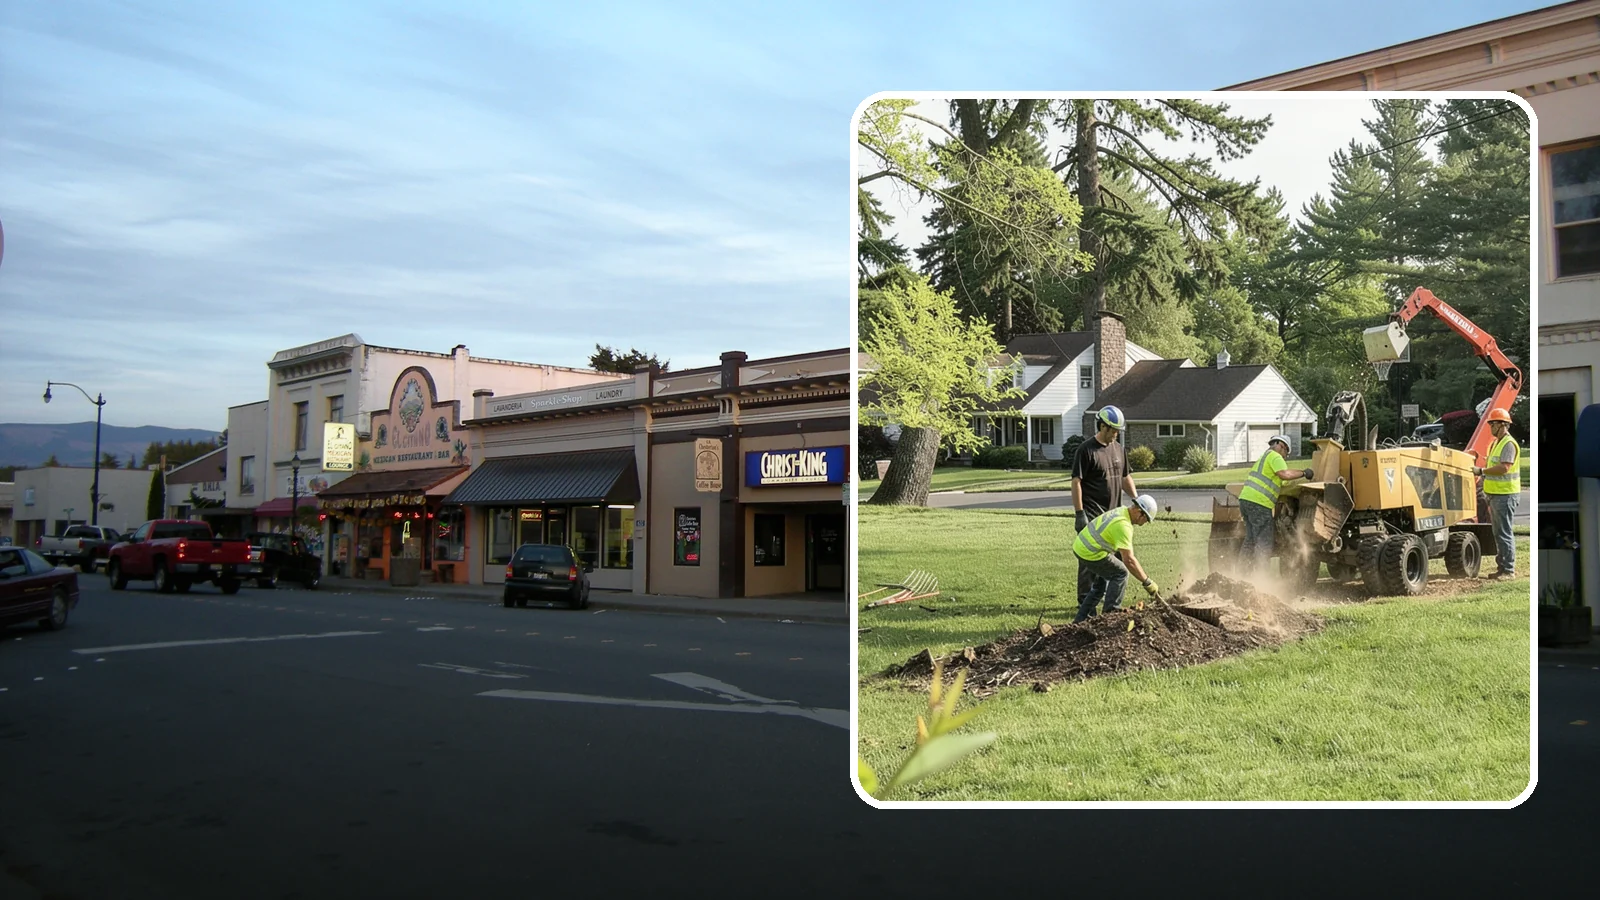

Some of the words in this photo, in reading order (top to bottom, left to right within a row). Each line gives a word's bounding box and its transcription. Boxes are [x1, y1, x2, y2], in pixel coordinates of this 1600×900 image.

[595, 389, 623, 399] LAUNDRY
[494, 402, 523, 412] LAVANDERIA
[530, 396, 560, 409] Sparkle
[561, 394, 583, 405] Shop
[373, 455, 396, 464] MEXICAN
[397, 451, 434, 462] RESTAURANT
[438, 450, 450, 459] BAR
[761, 452, 797, 478] CHRIST
[799, 450, 827, 476] KING
